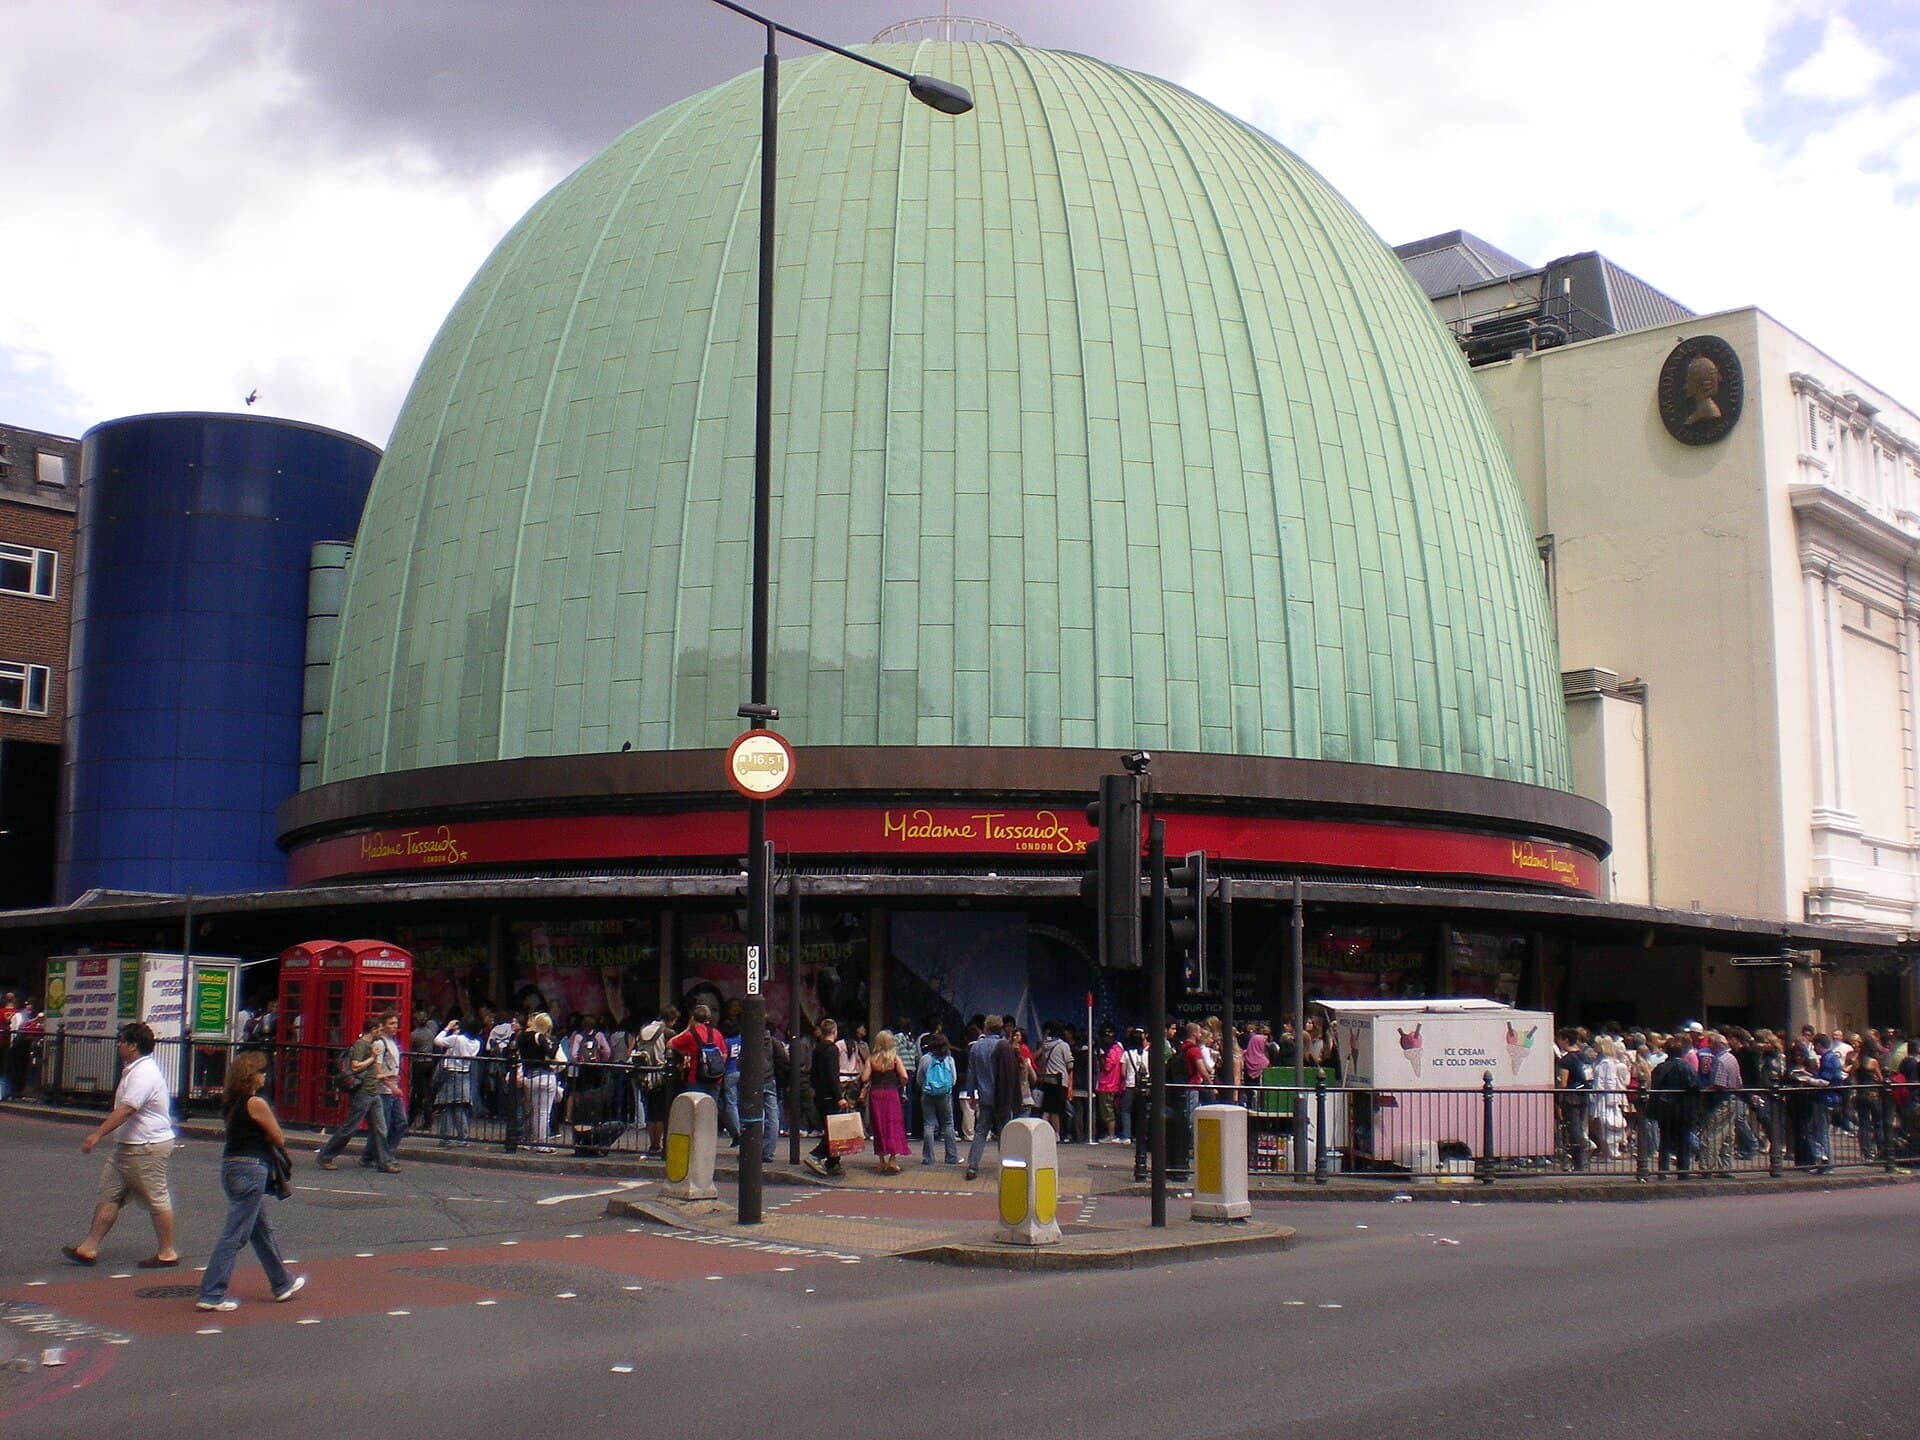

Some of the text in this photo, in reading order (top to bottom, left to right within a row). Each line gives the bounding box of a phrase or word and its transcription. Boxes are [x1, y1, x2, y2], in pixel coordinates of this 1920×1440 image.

[884, 809, 1074, 853] Madame Tussauds
[361, 825, 459, 863] Madame Tussauds
[1015, 842, 1053, 850] LONDON
[1444, 1048, 1486, 1056] ICE CREAM
[1432, 1059, 1497, 1067] ICE COLD DRINKS
